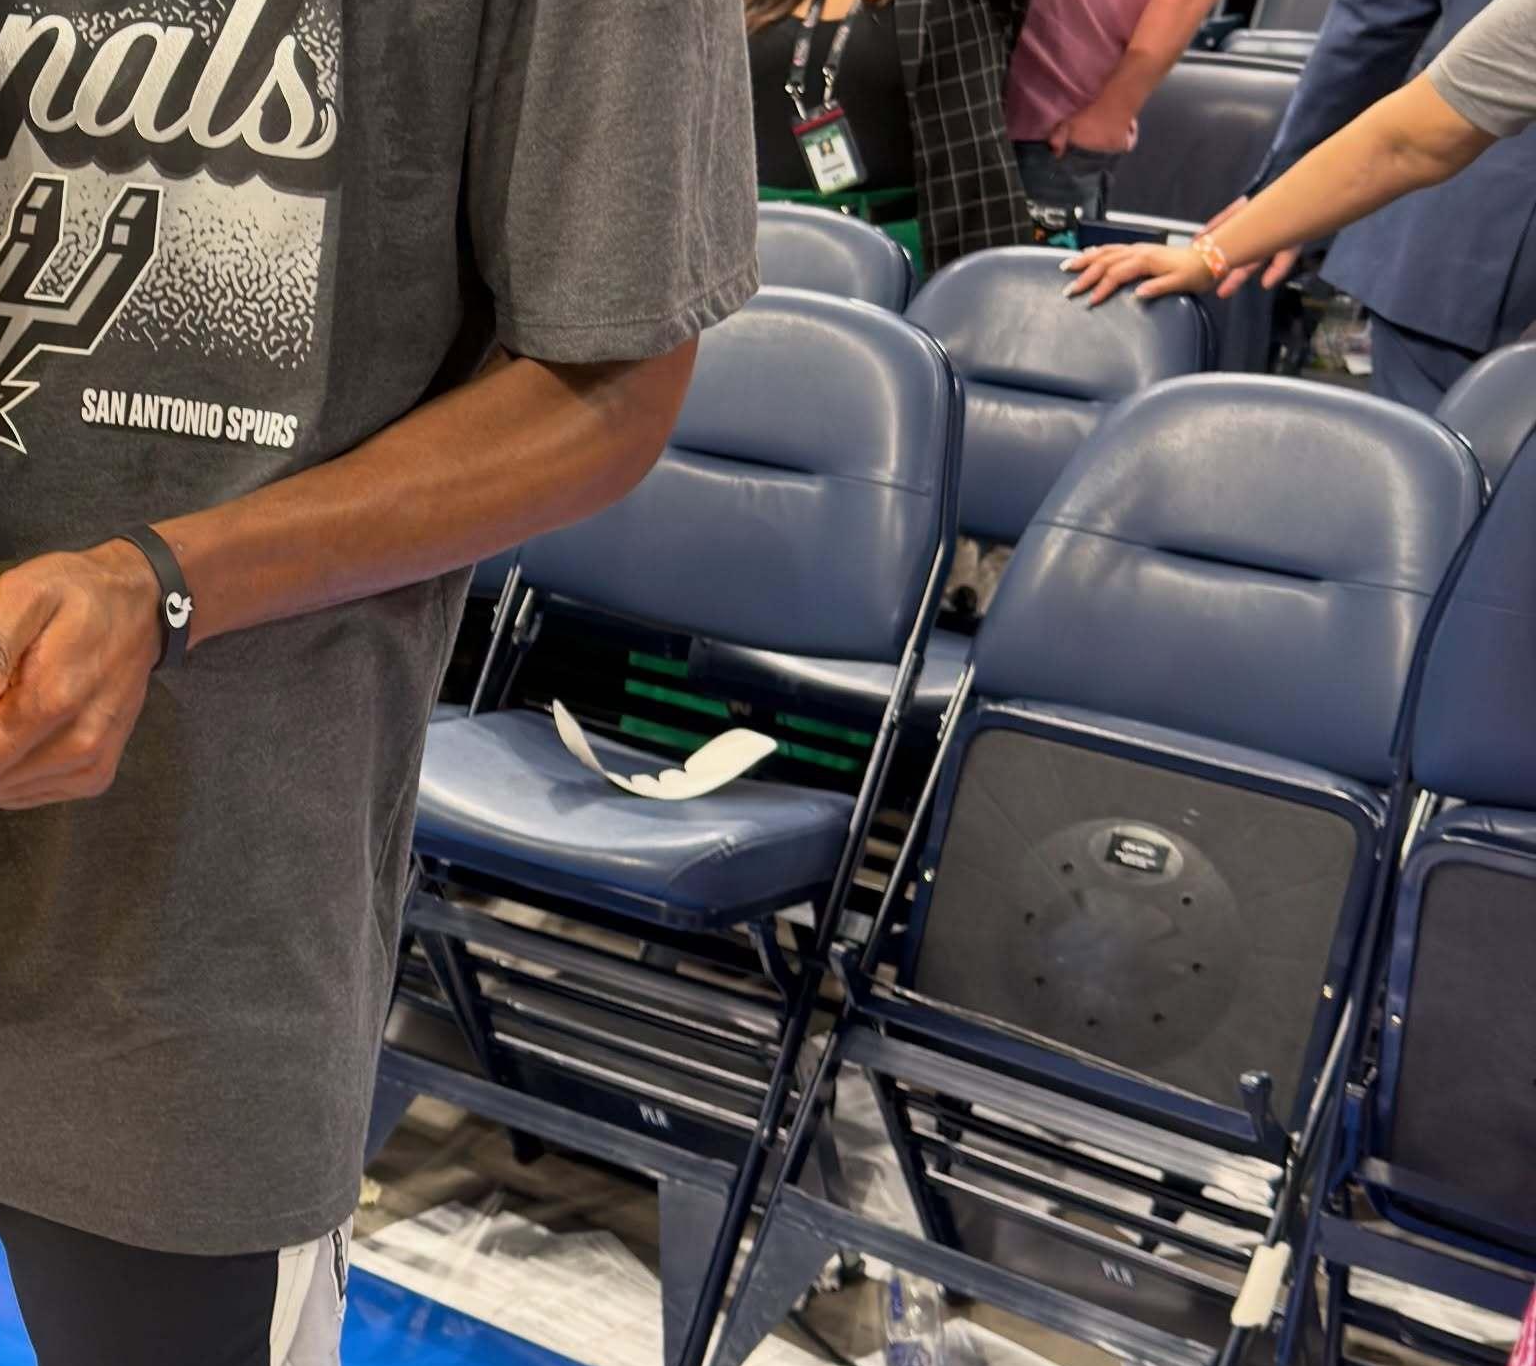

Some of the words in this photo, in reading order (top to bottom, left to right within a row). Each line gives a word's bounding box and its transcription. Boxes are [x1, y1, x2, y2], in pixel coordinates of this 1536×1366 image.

[81, 388, 127, 426] SAN
[128, 393, 224, 439] ANTONIO
[225, 406, 299, 450] SPURS
